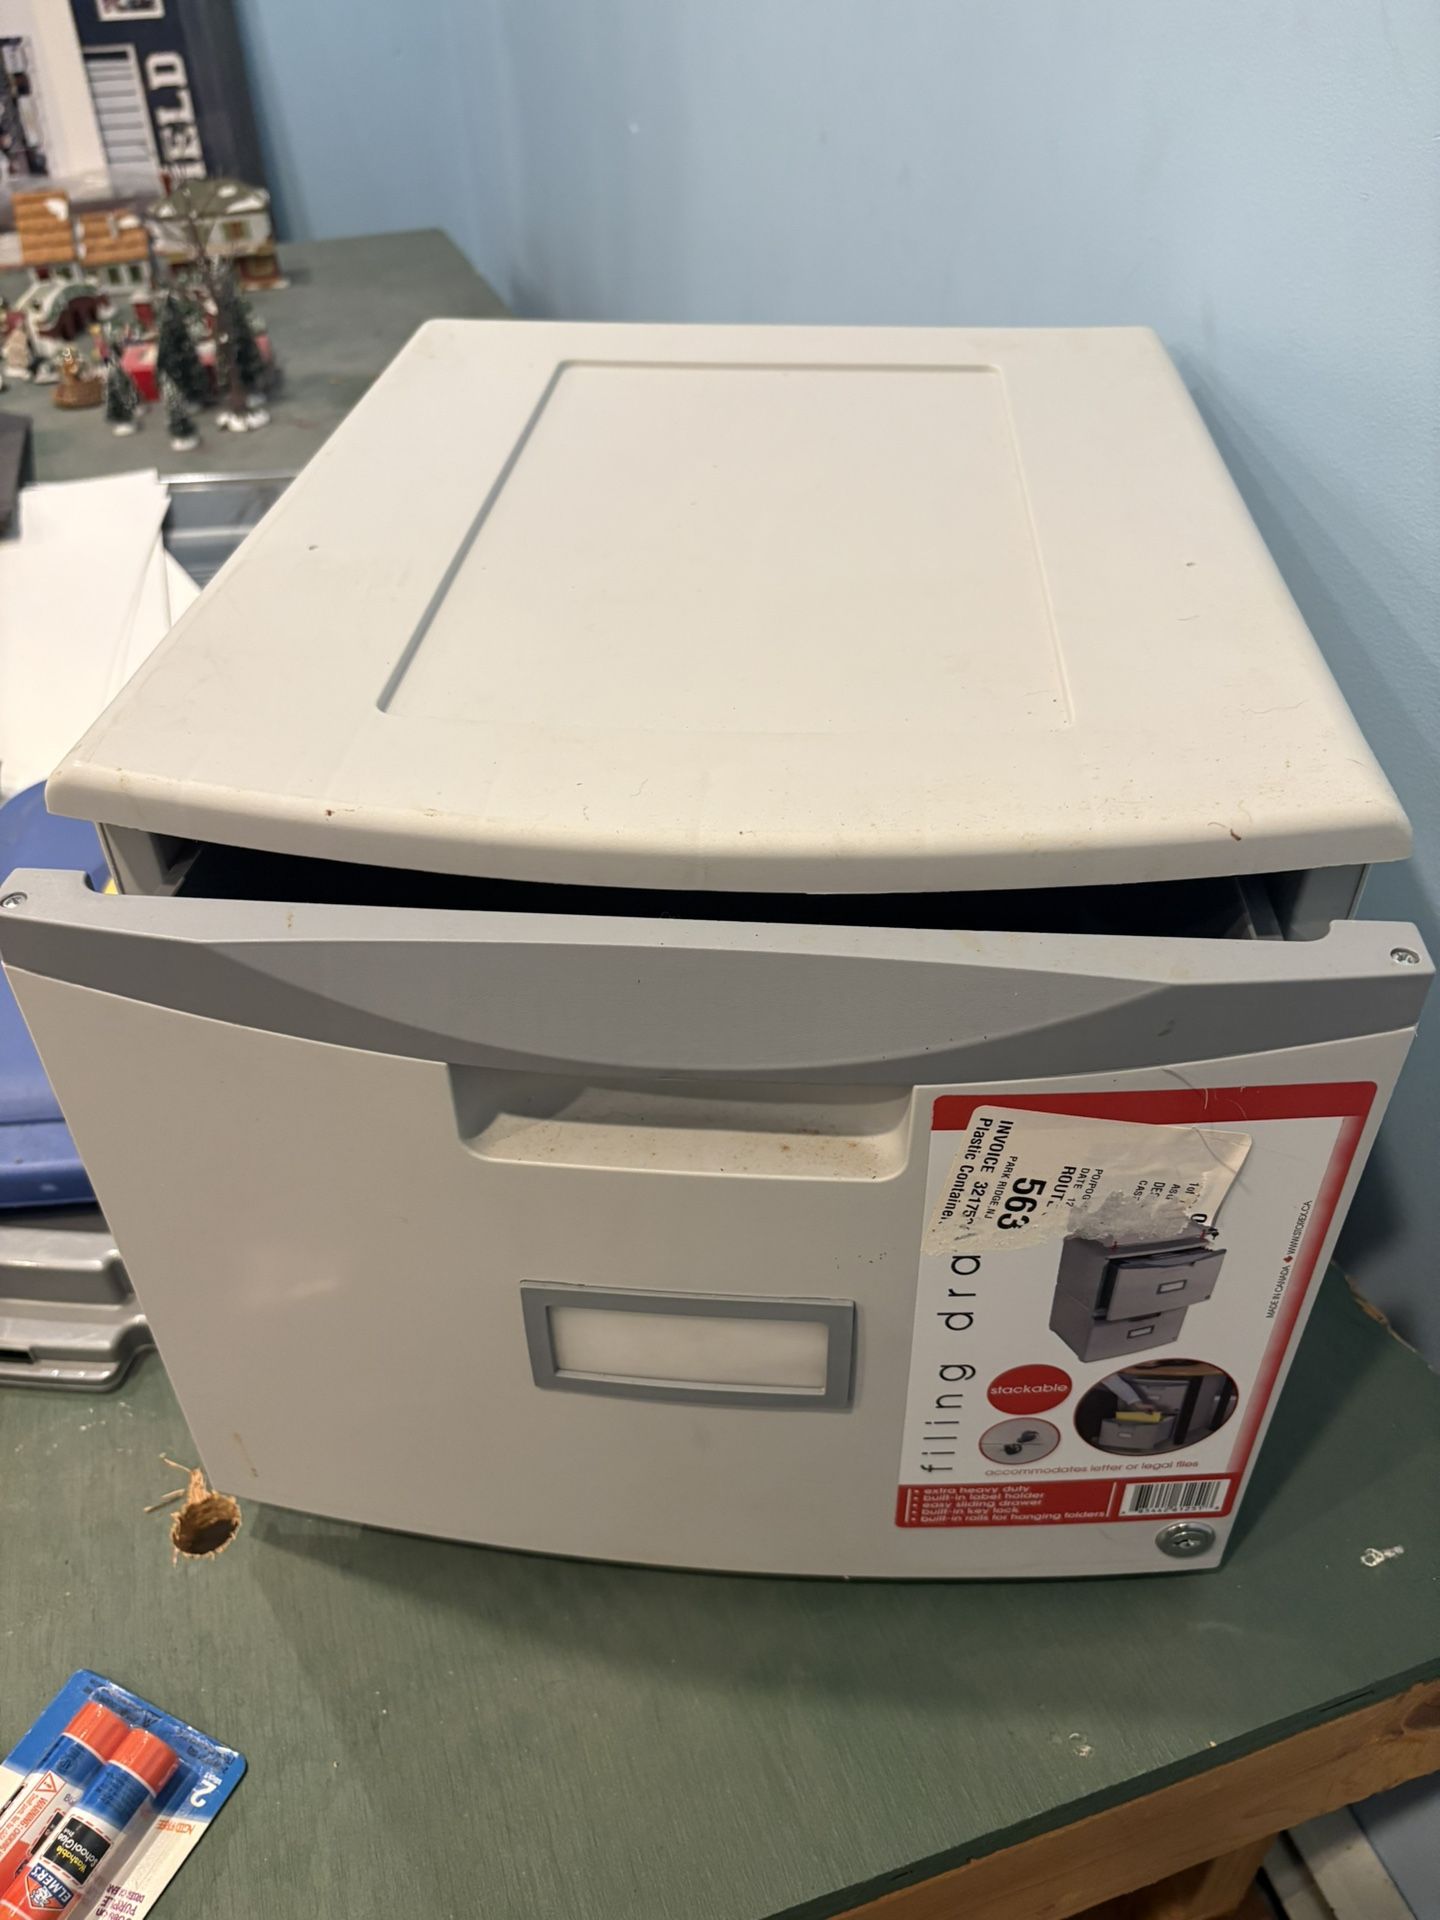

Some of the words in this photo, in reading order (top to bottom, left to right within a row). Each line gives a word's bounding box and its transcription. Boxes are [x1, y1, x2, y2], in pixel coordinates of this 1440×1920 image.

[965, 1117, 993, 1160] Plastic
[980, 1120, 1014, 1173] INVOICE
[1001, 1155, 1018, 1179] PARK
[1073, 1167, 1091, 1190] DATE
[1046, 1165, 1077, 1207] ROUT
[997, 1177, 1047, 1230] 563
[937, 1254, 982, 1331] dra
[1266, 1300, 1279, 1319] MADE
[1274, 1265, 1291, 1292] CANADA
[990, 1383, 1069, 1395] stackable
[985, 1465, 1088, 1477] accommodates
[1090, 1463, 1122, 1472] letter
[1141, 1461, 1173, 1472] legal
[1176, 1459, 1199, 1469] files
[959, 1486, 999, 1495] heavy
[1002, 1485, 1031, 1494] duty
[969, 1492, 1002, 1500] label
[1004, 1491, 1045, 1499] holder
[999, 1498, 1043, 1506] drawer
[992, 1512, 1008, 1521] for
[1010, 1512, 1061, 1521] hanging
[190, 1779, 217, 1808] 2
[56, 1845, 87, 1873] Washable
[72, 1844, 99, 1867] School
[31, 1866, 72, 1902] ELMER'S
